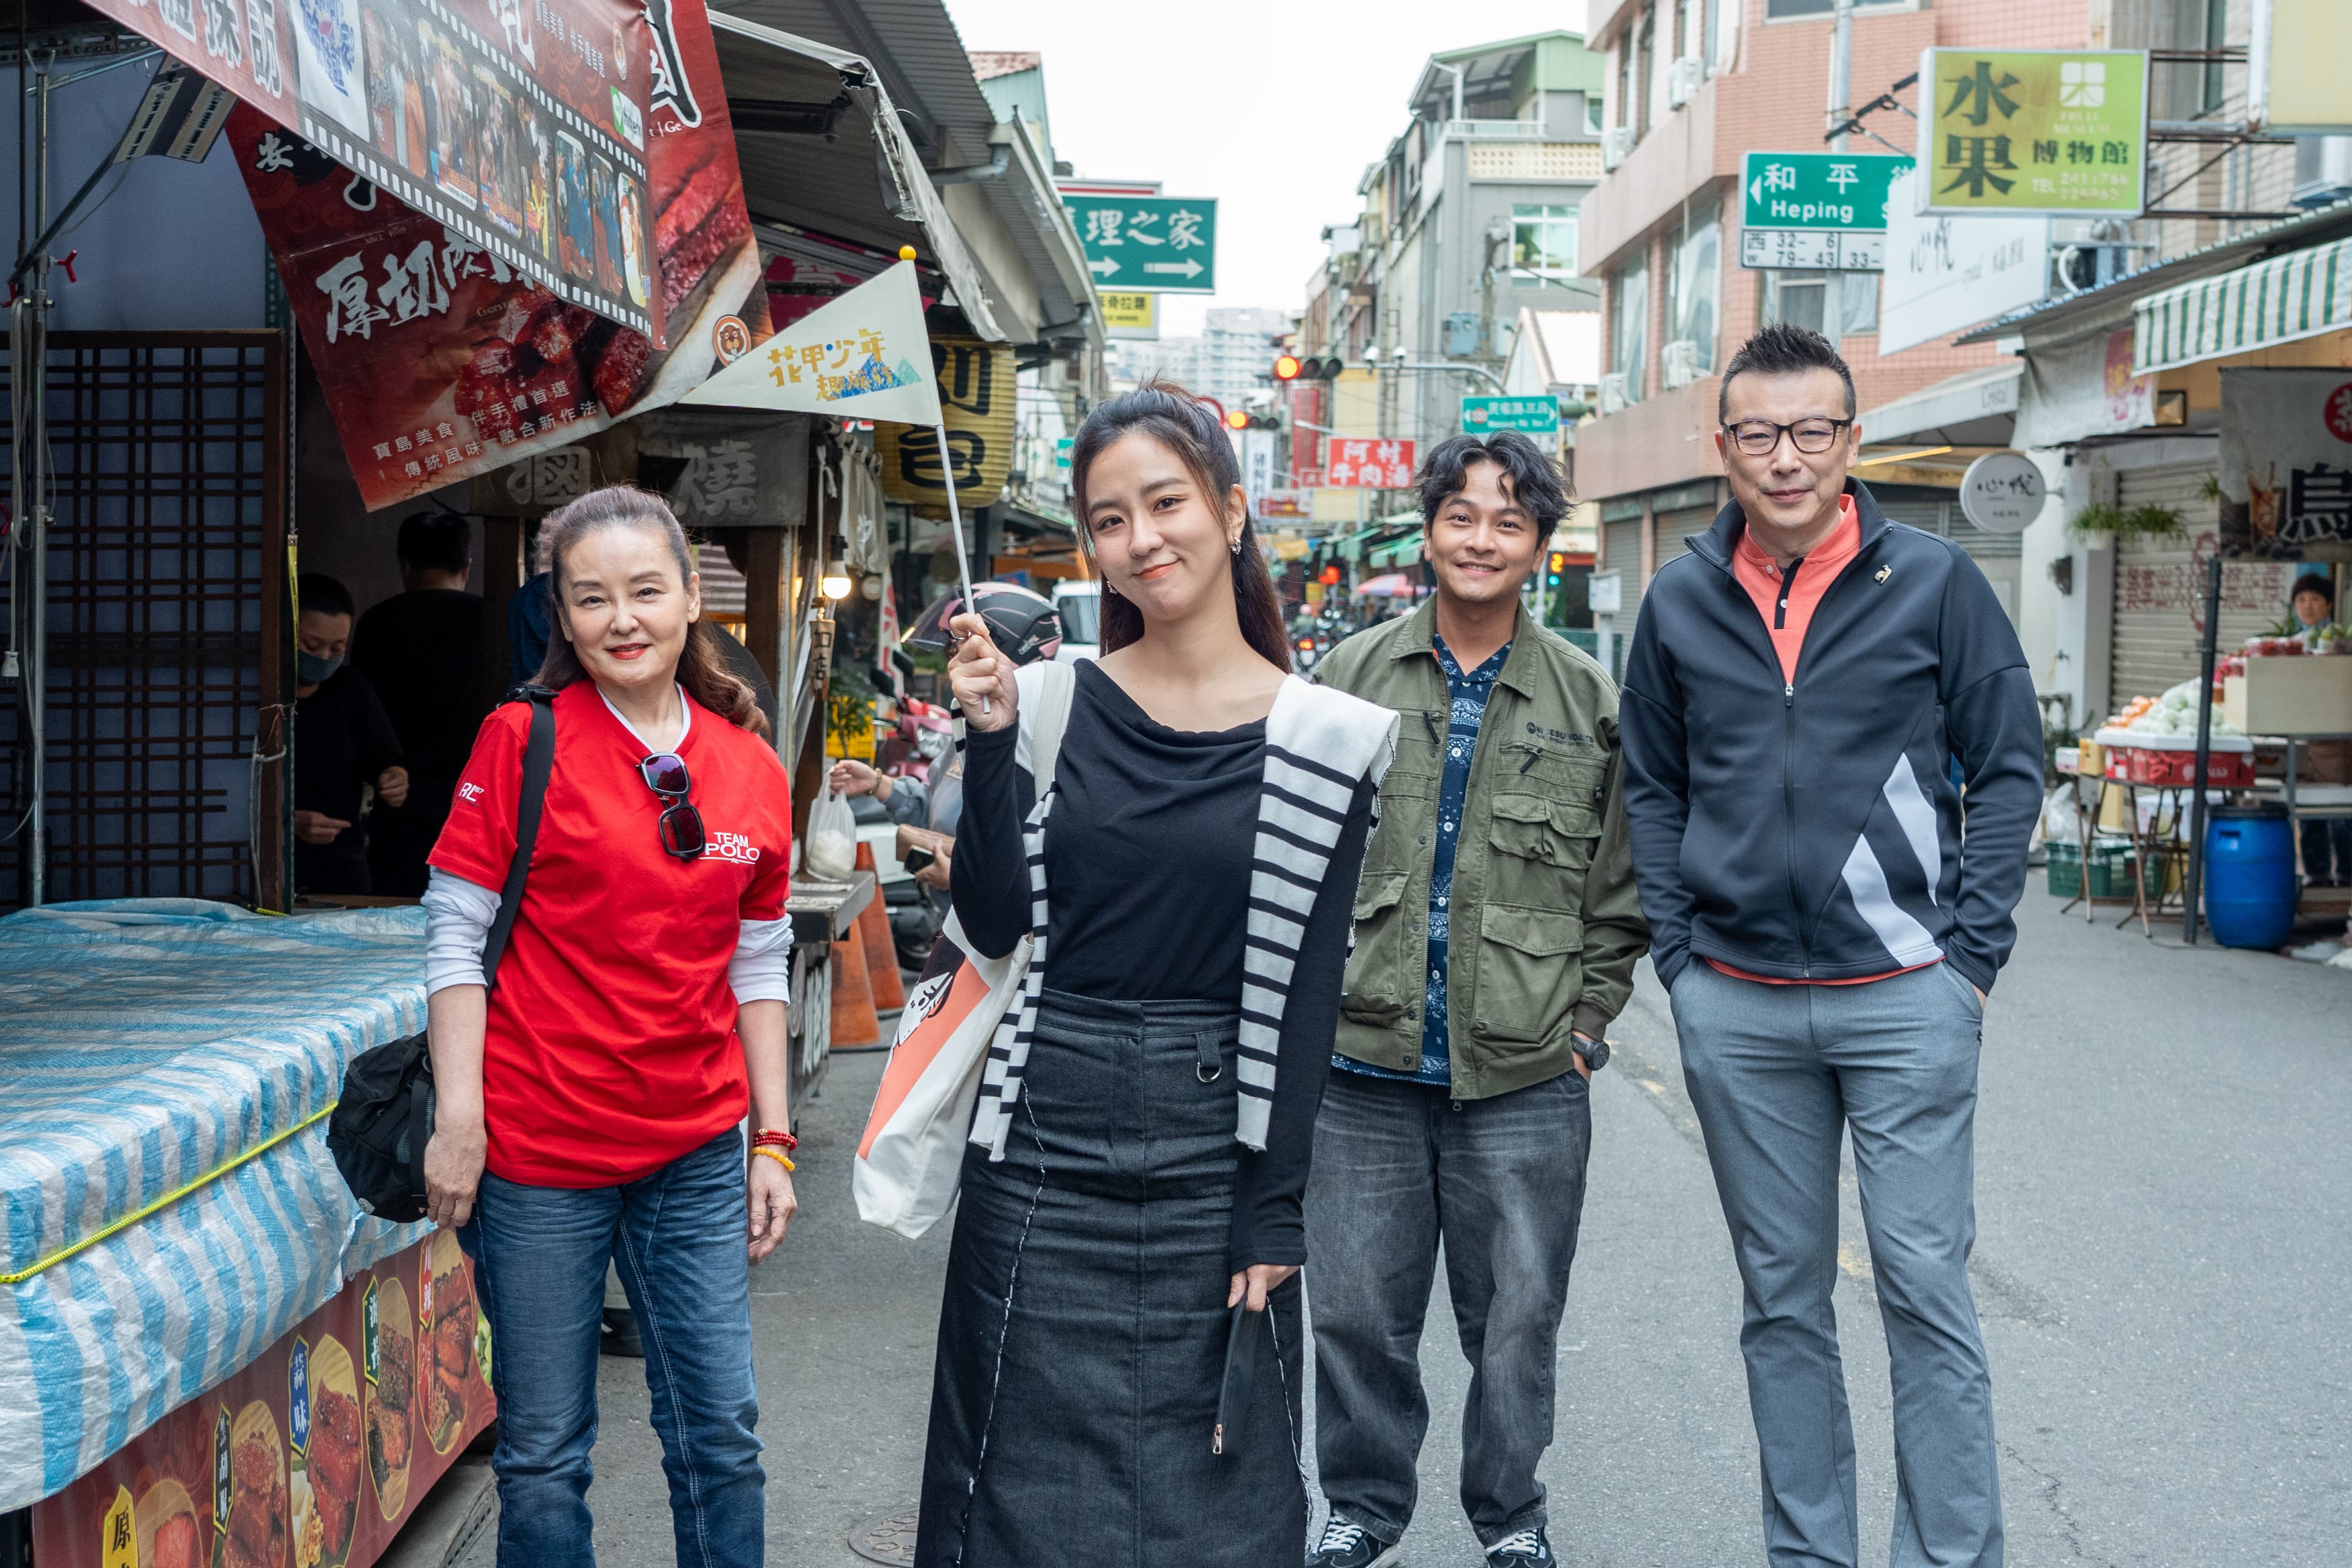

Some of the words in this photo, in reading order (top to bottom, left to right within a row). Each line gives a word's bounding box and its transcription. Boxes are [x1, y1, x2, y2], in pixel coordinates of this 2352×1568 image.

[1940, 61, 2021, 198] 水果
[2032, 140, 2129, 165] 博物館
[1771, 200, 1853, 224] Heping
[767, 328, 886, 388] 花甲少年
[816, 366, 893, 402] 趣旅行
[372, 422, 454, 461] 寶島美食
[471, 380, 570, 428] 伴手禮首選
[404, 440, 483, 478] 傳統風味
[499, 400, 598, 445] 融合新作法
[1343, 440, 1403, 464] 阿村
[1332, 462, 1411, 488] 牛肉湯
[705, 843, 760, 861] POLO
[713, 832, 749, 848] TEAM
[111, 1504, 131, 1568] 原
